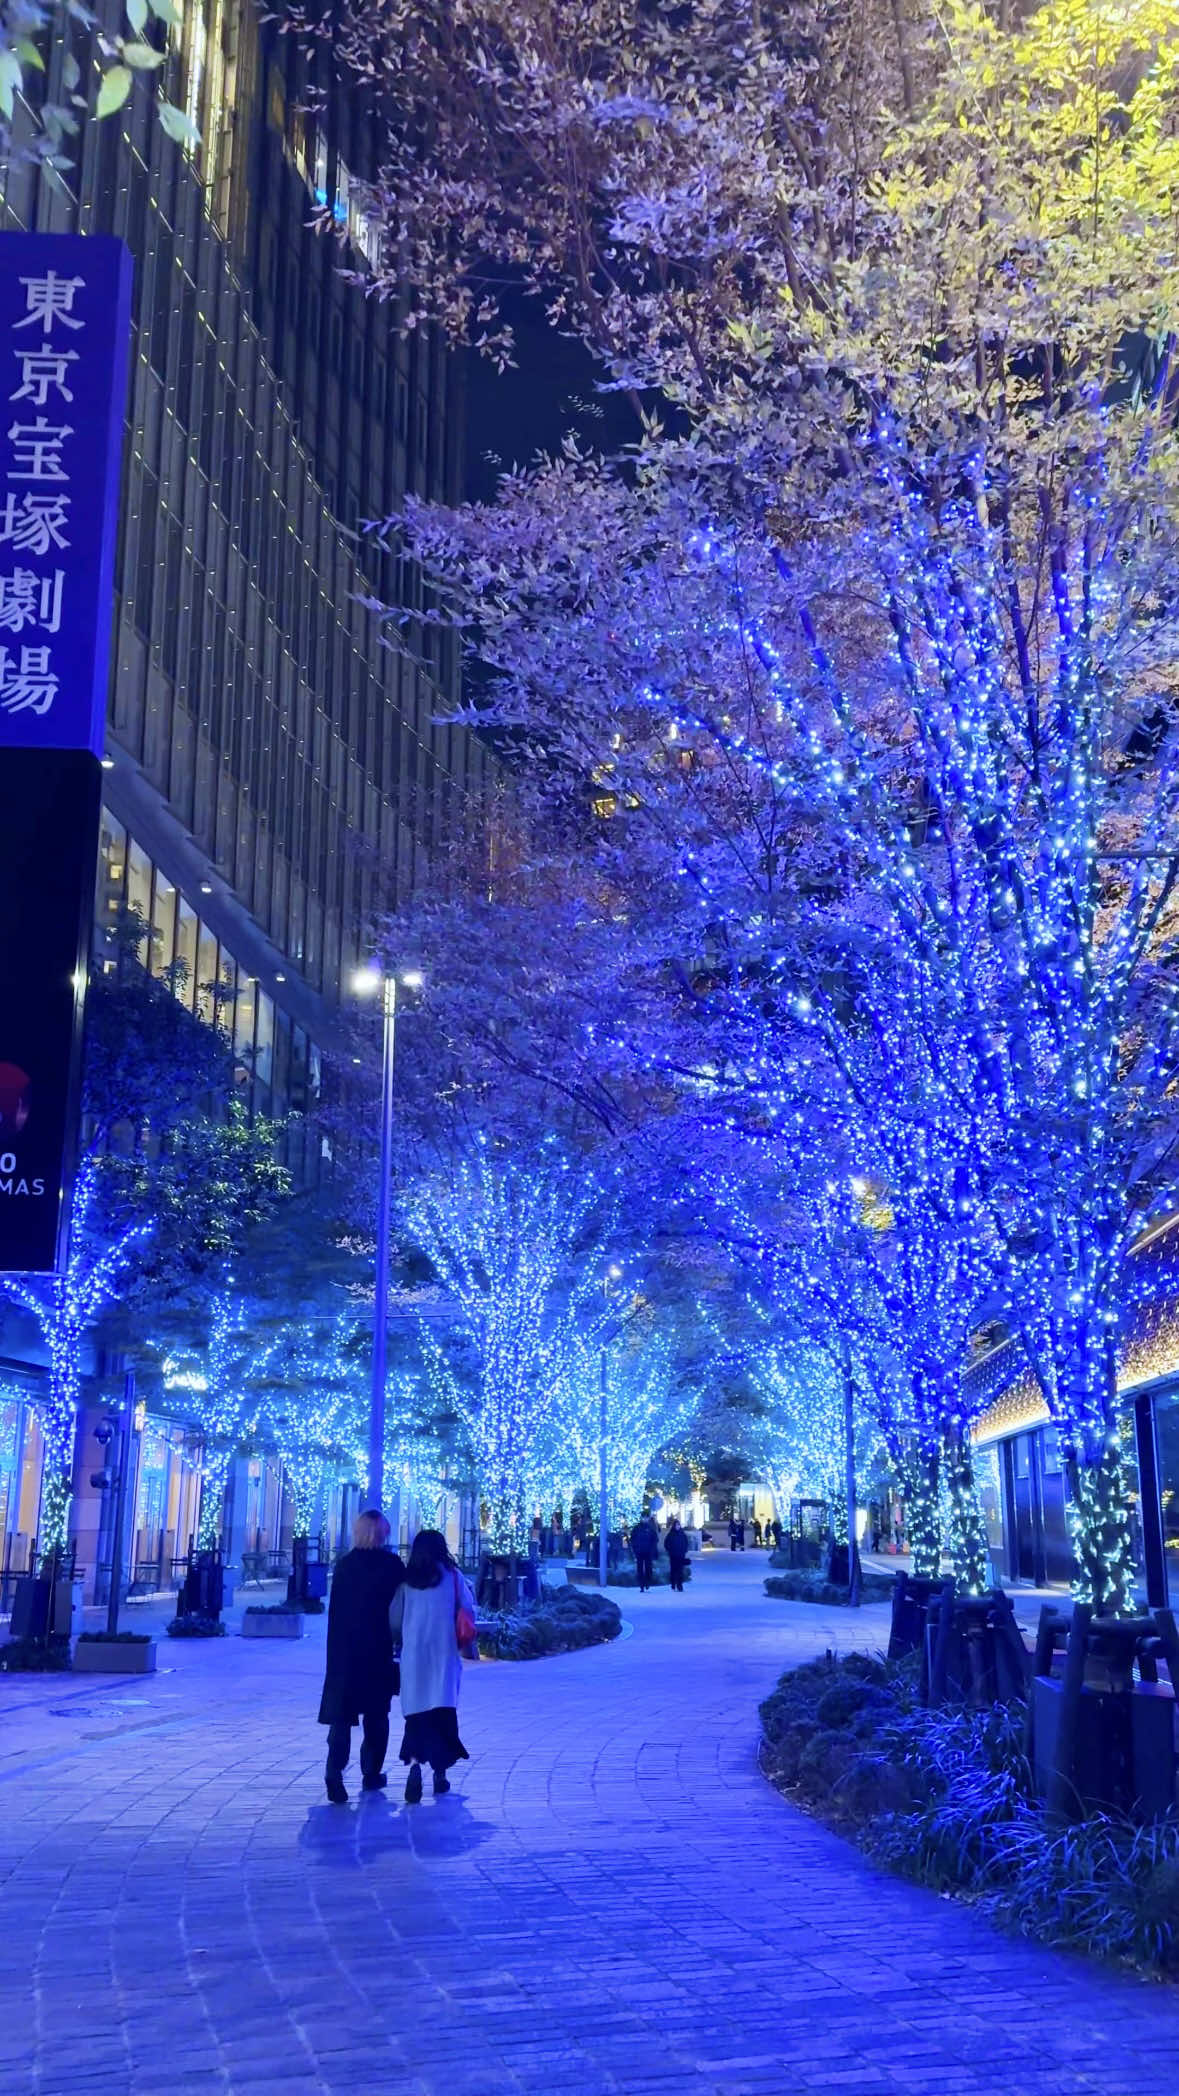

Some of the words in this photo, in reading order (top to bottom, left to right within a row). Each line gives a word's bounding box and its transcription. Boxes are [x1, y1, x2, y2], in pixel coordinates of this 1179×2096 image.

[0, 270, 85, 715] 東京宝塚劇場
